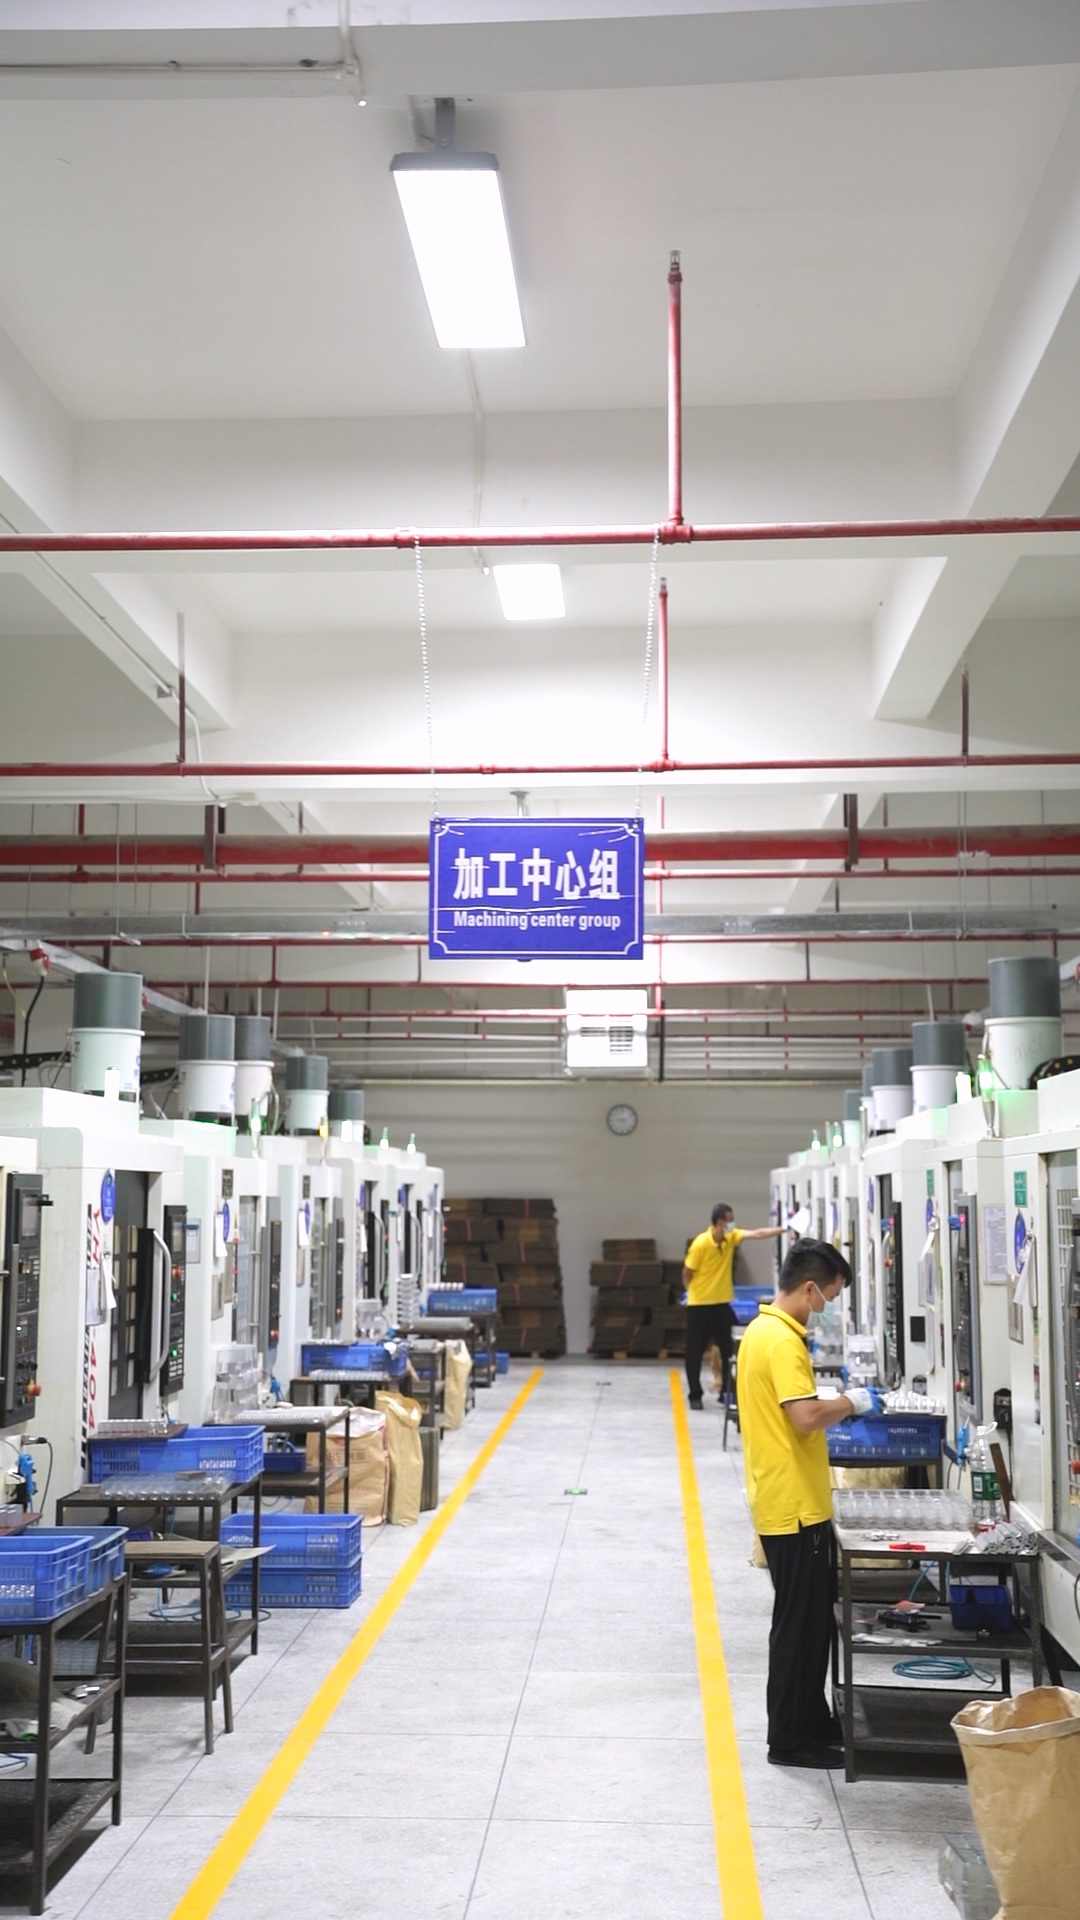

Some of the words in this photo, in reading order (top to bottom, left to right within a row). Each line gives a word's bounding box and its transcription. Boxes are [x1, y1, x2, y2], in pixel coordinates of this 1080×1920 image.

[453, 847, 620, 901] 加工中心组
[454, 911, 528, 930] Machining
[530, 912, 576, 927] center
[579, 915, 621, 931] group
